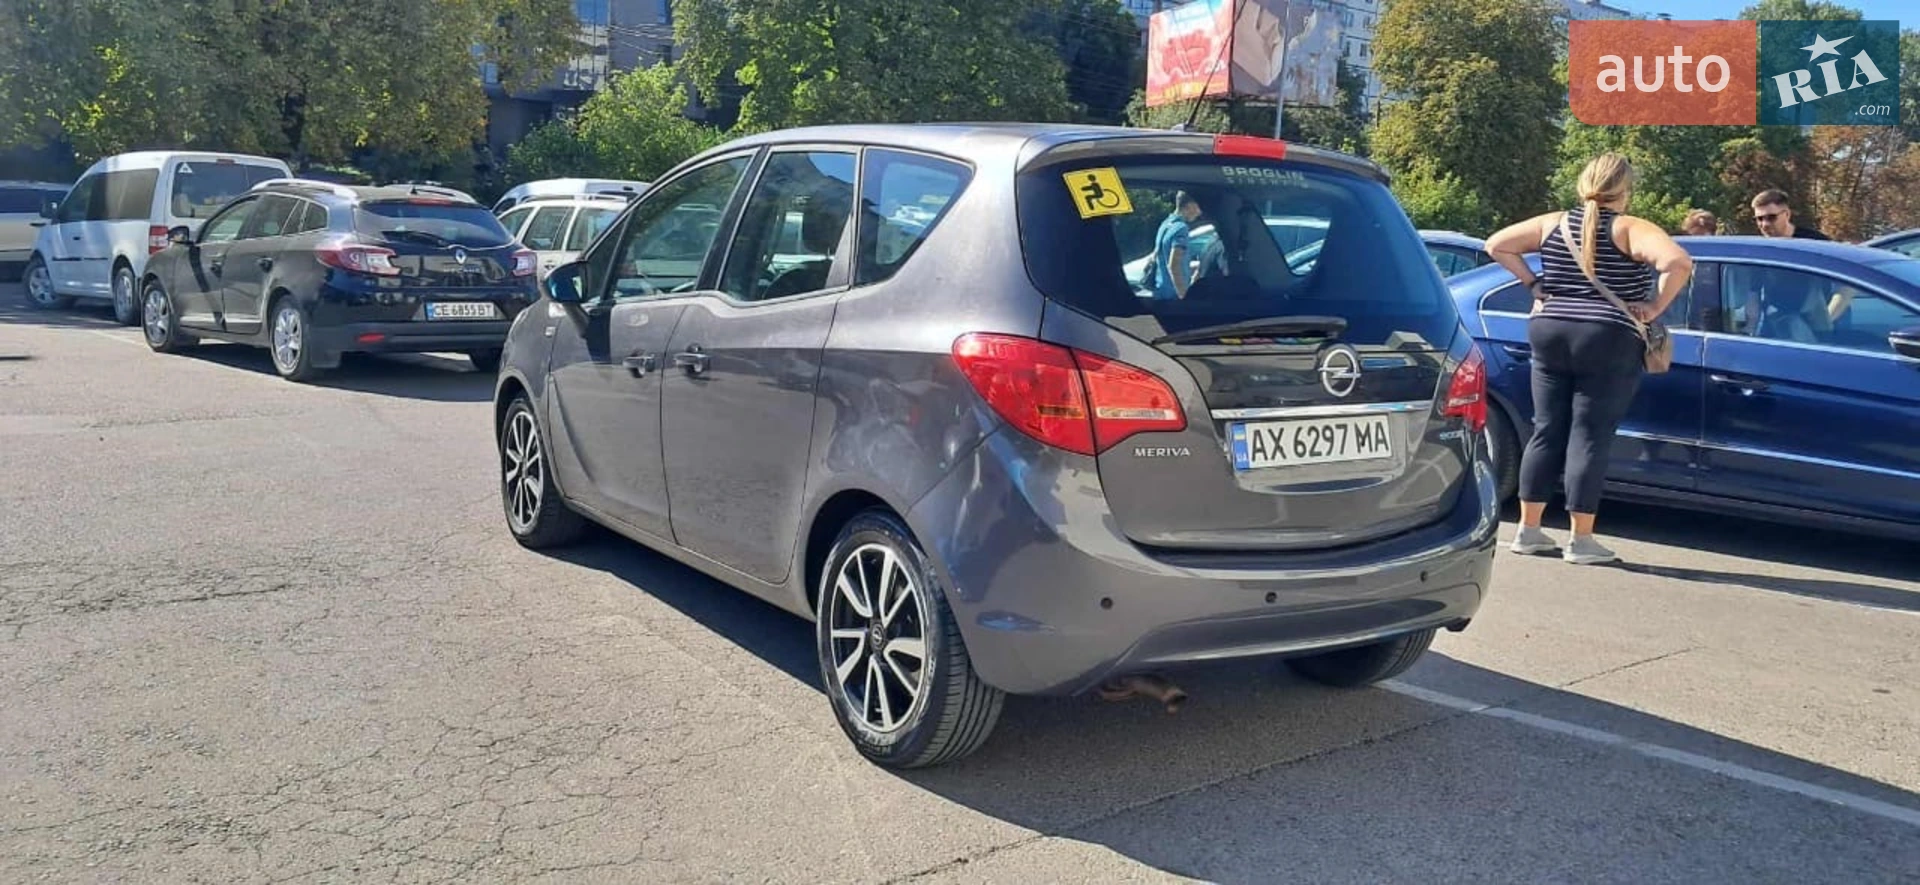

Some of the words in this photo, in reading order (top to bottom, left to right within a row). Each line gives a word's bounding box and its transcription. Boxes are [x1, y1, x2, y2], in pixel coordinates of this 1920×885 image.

[434, 305, 449, 316] CE
[1251, 427, 1287, 462] AX
[1293, 424, 1348, 459] 6297
[1354, 421, 1390, 454] MA
[1134, 447, 1191, 457] MERIVA
